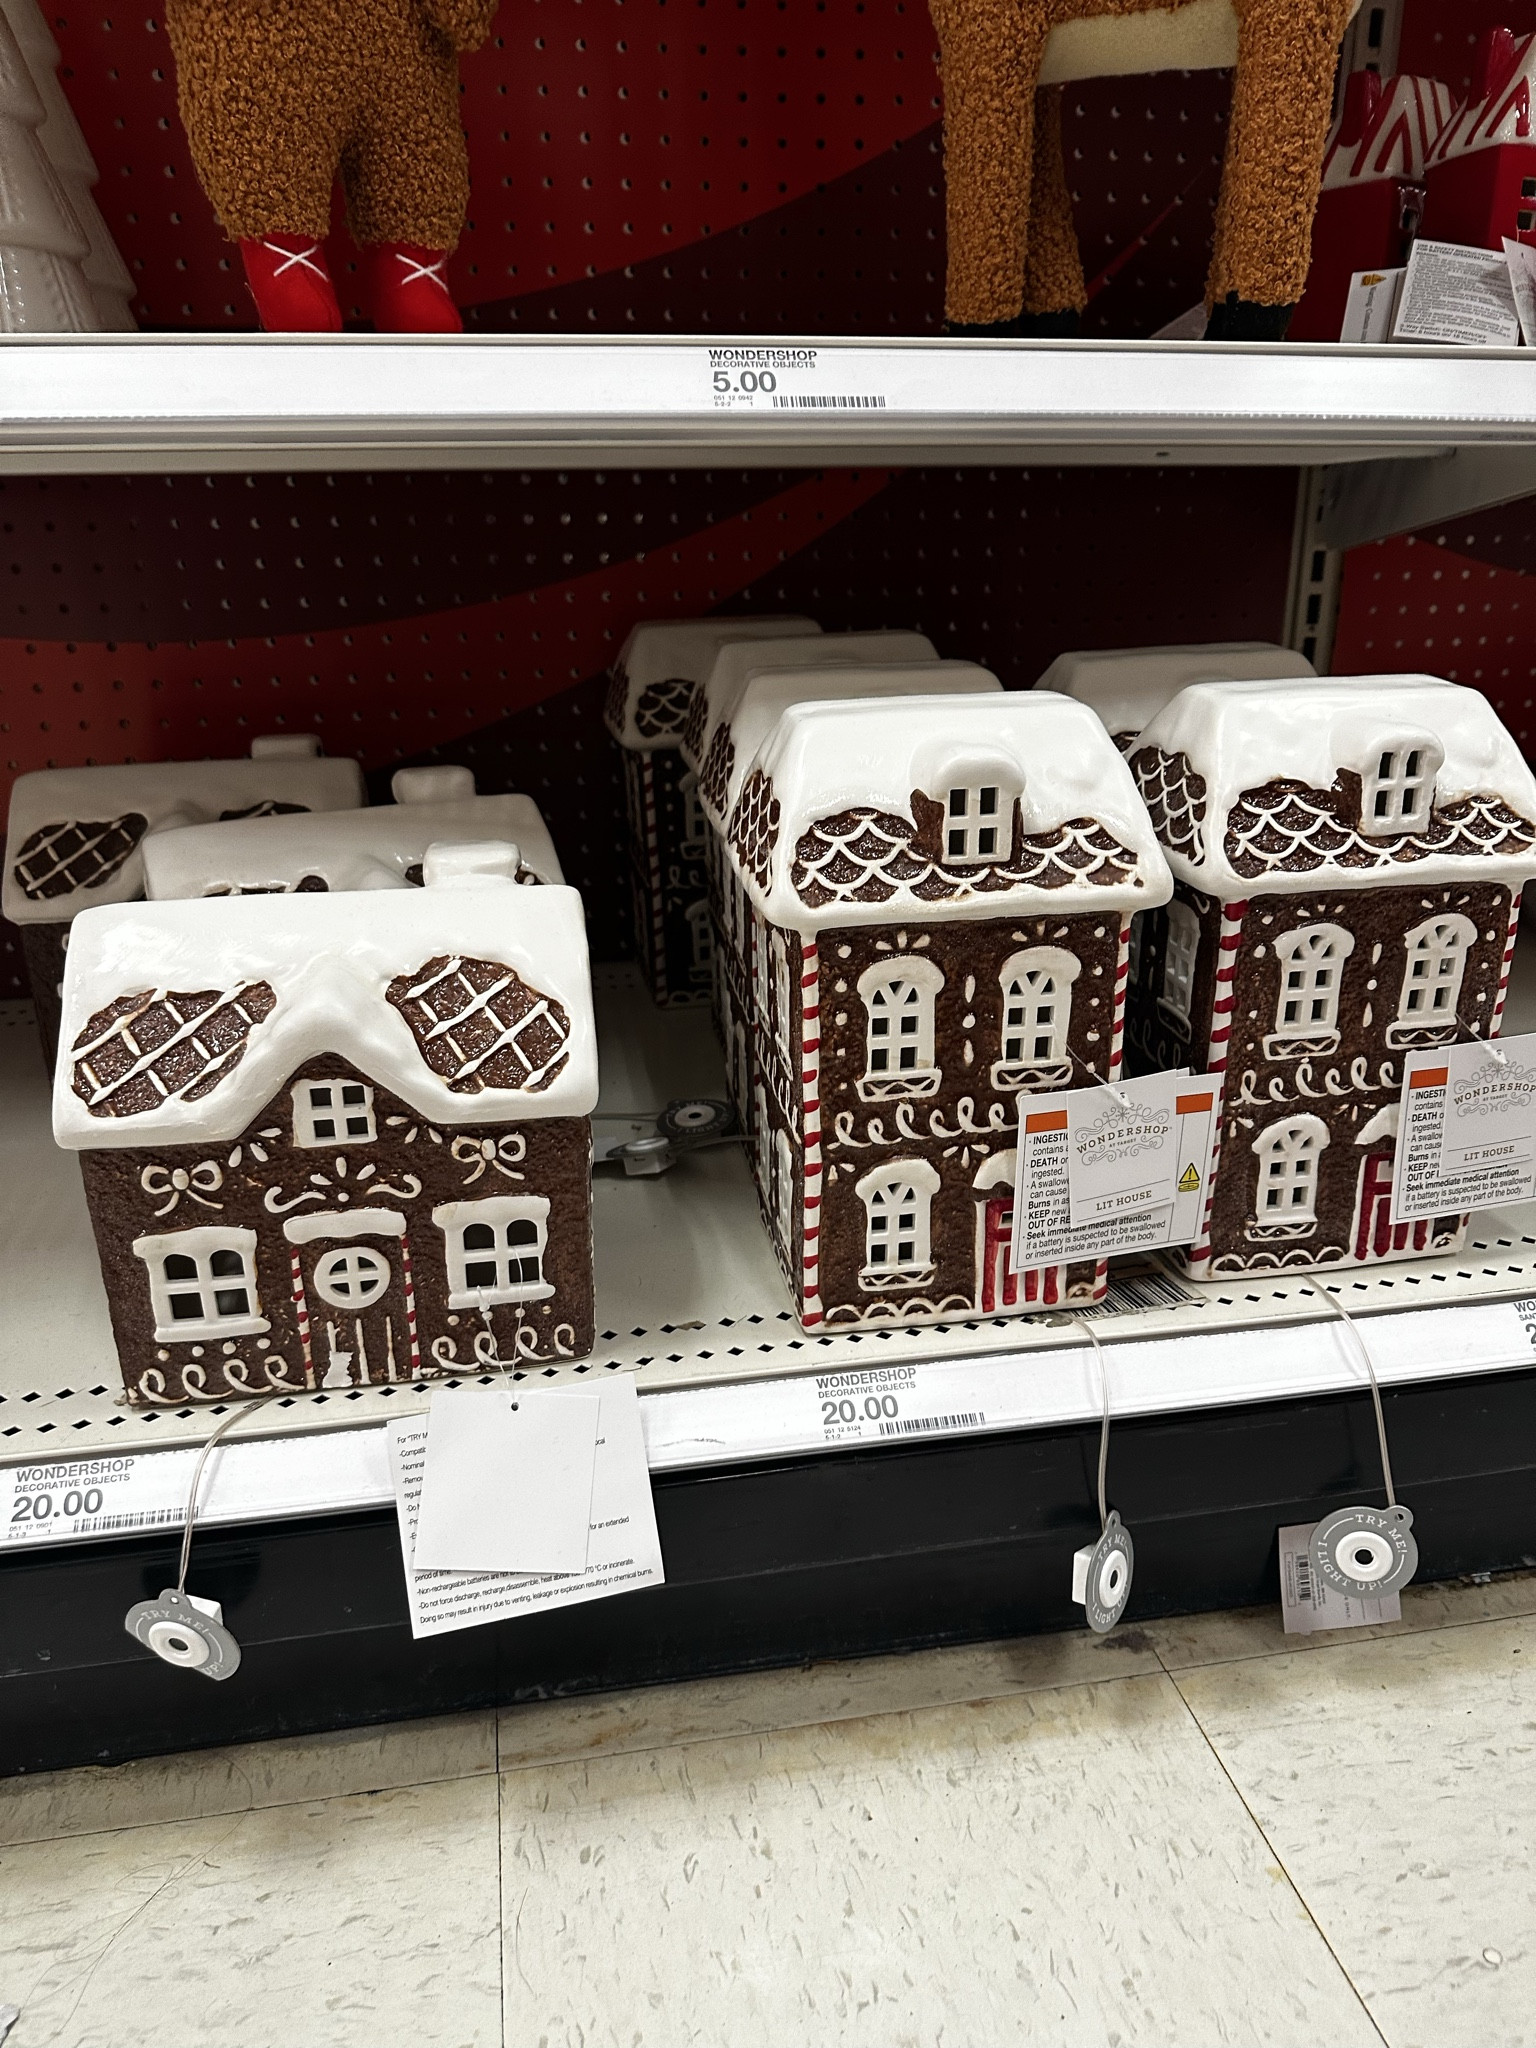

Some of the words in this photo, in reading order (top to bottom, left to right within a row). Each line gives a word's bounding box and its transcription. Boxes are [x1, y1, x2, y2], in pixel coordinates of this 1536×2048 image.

[708, 350, 818, 361] WONDERSHOP
[713, 370, 777, 393] 5.00
[1454, 1082, 1536, 1104] WONDERSHOP
[1414, 1101, 1443, 1110] contains
[1412, 1112, 1438, 1122] DEATH
[1077, 1126, 1168, 1154] WONDERSHOP
[1410, 1144, 1422, 1152] can
[1032, 1145, 1064, 1156] contains
[1408, 1154, 1429, 1162] Burns
[1464, 1152, 1480, 1162] LIT
[1482, 1146, 1514, 1158] HOUSE
[1030, 1156, 1058, 1168] DEATH
[1408, 1162, 1428, 1172] KEEP
[1032, 1166, 1064, 1180] ingested.
[1406, 1182, 1424, 1192] Seek
[1425, 1178, 1460, 1189] immediate
[1462, 1172, 1489, 1183] medical
[1490, 1169, 1520, 1180] attention
[1408, 1172, 1424, 1182] OUT
[1425, 1170, 1436, 1180] OF
[1030, 1180, 1036, 1190] A
[1030, 1190, 1044, 1199] can
[1046, 1188, 1067, 1197] cause
[1417, 1191, 1440, 1200] battery
[1448, 1184, 1480, 1196] suspected
[1500, 1176, 1532, 1188] swallowed
[1028, 1200, 1050, 1210] Burns
[1052, 1198, 1060, 1206] in
[1096, 1200, 1113, 1211] LIT
[1116, 1190, 1152, 1206] HOUSE
[1404, 1204, 1412, 1212] or
[1413, 1199, 1440, 1210] inserted
[1441, 1196, 1460, 1206] inside
[1460, 1196, 1472, 1204] any
[1474, 1192, 1486, 1202] part
[1488, 1190, 1494, 1198] of
[1506, 1186, 1524, 1195] body.
[1028, 1209, 1050, 1220] KEEP
[1052, 1208, 1066, 1216] new
[1027, 1230, 1046, 1240] Seek
[1088, 1218, 1118, 1230] medical
[1120, 1214, 1152, 1224] attention
[1028, 1220, 1045, 1230] OUT
[1047, 1218, 1058, 1226] OF
[1039, 1237, 1064, 1248] battery
[1073, 1228, 1108, 1242] suspected
[1110, 1228, 1118, 1236] to
[1120, 1226, 1128, 1234] be
[1130, 1220, 1166, 1232] swallowed
[1026, 1252, 1033, 1260] or
[1034, 1246, 1062, 1258] inserted
[1064, 1242, 1085, 1252] inside
[1086, 1242, 1099, 1250] any
[1100, 1238, 1114, 1248] part
[1116, 1235, 1124, 1244] of
[1138, 1231, 1156, 1241] body.
[816, 1367, 916, 1389] WONDERSHOP
[818, 1386, 874, 1398] DECORATIVE
[876, 1381, 916, 1392] OBJECTS
[822, 1394, 899, 1425] 20.00
[397, 1436, 406, 1444] For
[16, 1459, 134, 1482] WONDERSHOP
[14, 1480, 80, 1493] DECORATIVE
[83, 1474, 130, 1486] OBJECTS
[10, 1488, 104, 1522] 20.00
[606, 1516, 630, 1528] extended
[1356, 1514, 1388, 1528] TRY
[1388, 1528, 1408, 1553] ME!
[1097, 1536, 1112, 1560] TRY
[1114, 1533, 1127, 1546] ME!
[414, 1572, 432, 1583] period
[466, 1574, 490, 1586] batteries
[490, 1572, 500, 1580] are
[1318, 1550, 1352, 1587] LIGHT
[1356, 1582, 1383, 1591] UP!
[420, 1615, 436, 1624] Doing
[444, 1610, 457, 1619] may
[458, 1606, 472, 1616] result
[479, 1602, 493, 1612] injury
[494, 1600, 504, 1608] due
[512, 1594, 532, 1604] venting,
[532, 1590, 553, 1600] leakage
[560, 1583, 585, 1594] explosion
[586, 1577, 608, 1588] resulting
[614, 1572, 636, 1582] chemical
[637, 1568, 654, 1576] burns.
[440, 1596, 453, 1606] force
[540, 1576, 552, 1584] heat
[140, 1610, 171, 1620] TRY
[178, 1613, 210, 1634] ME!
[1094, 1606, 1117, 1624] LIGHT
